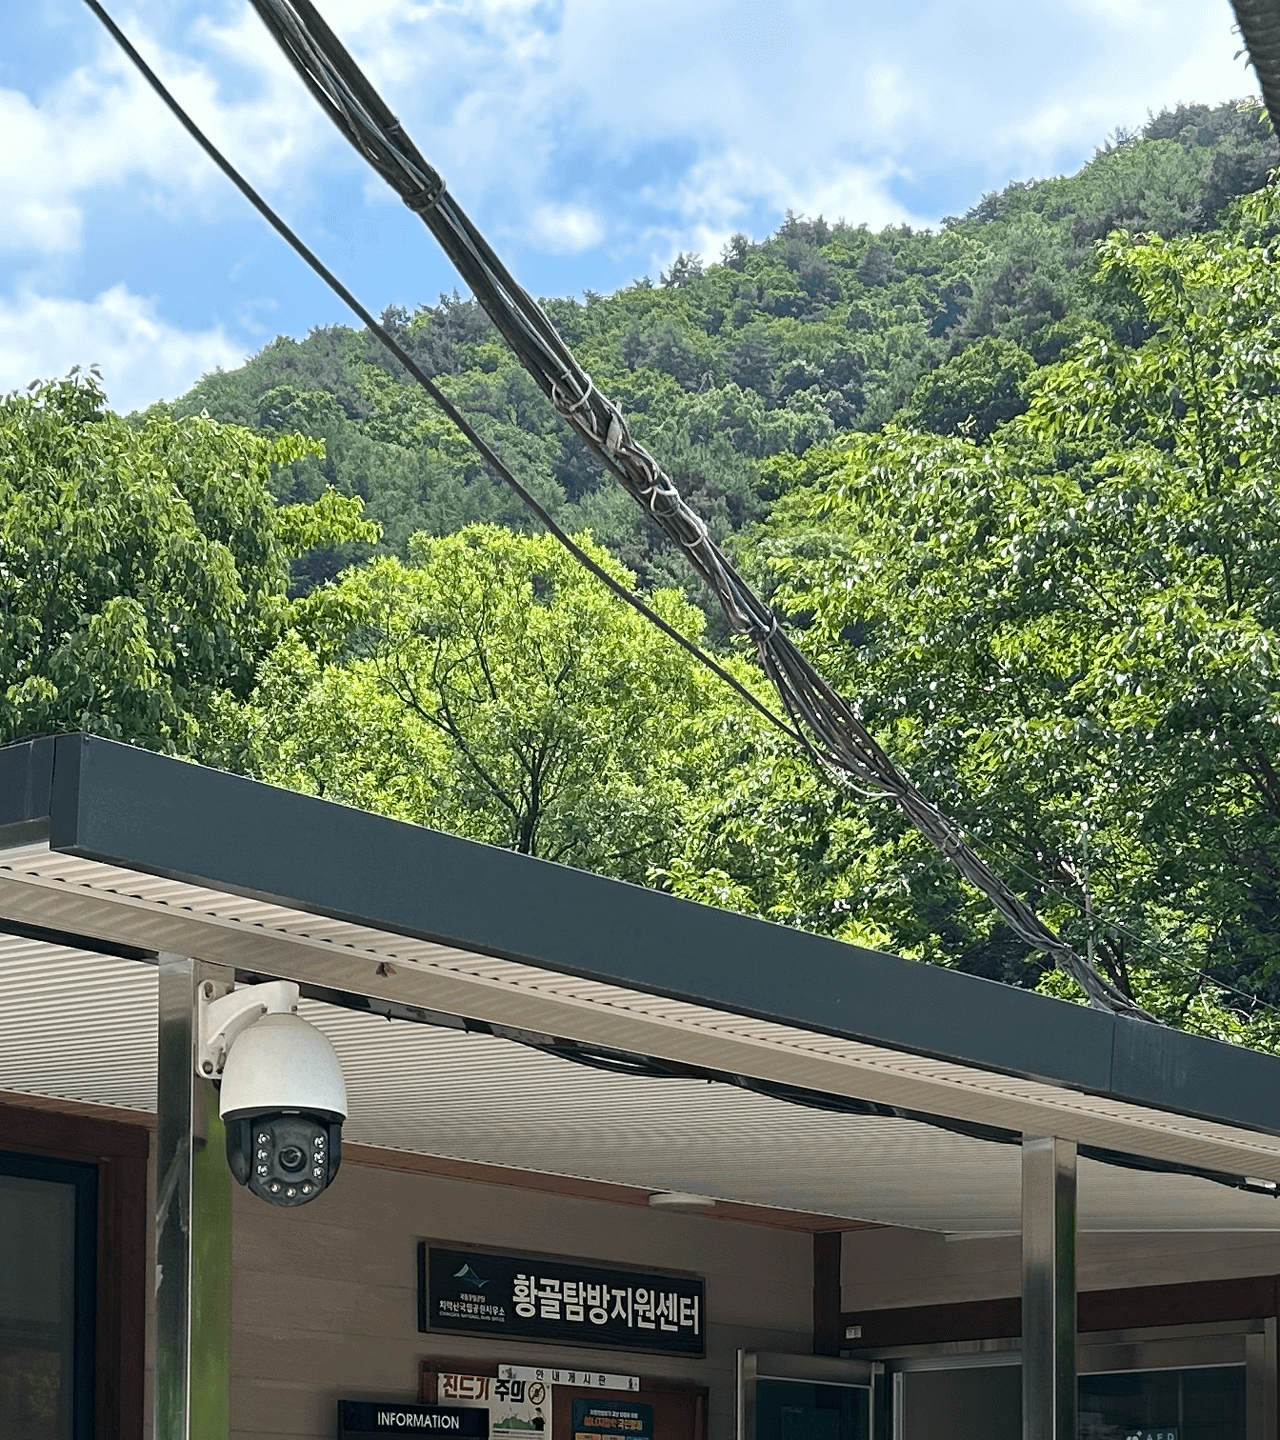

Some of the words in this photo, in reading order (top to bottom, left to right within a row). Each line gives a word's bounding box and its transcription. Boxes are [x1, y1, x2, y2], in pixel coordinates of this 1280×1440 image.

[512, 1273, 700, 1335] 황골탐방지원센터
[442, 1374, 491, 1401] 진드기
[494, 1379, 526, 1403] 주의
[377, 1411, 460, 1430] INFORMATION
